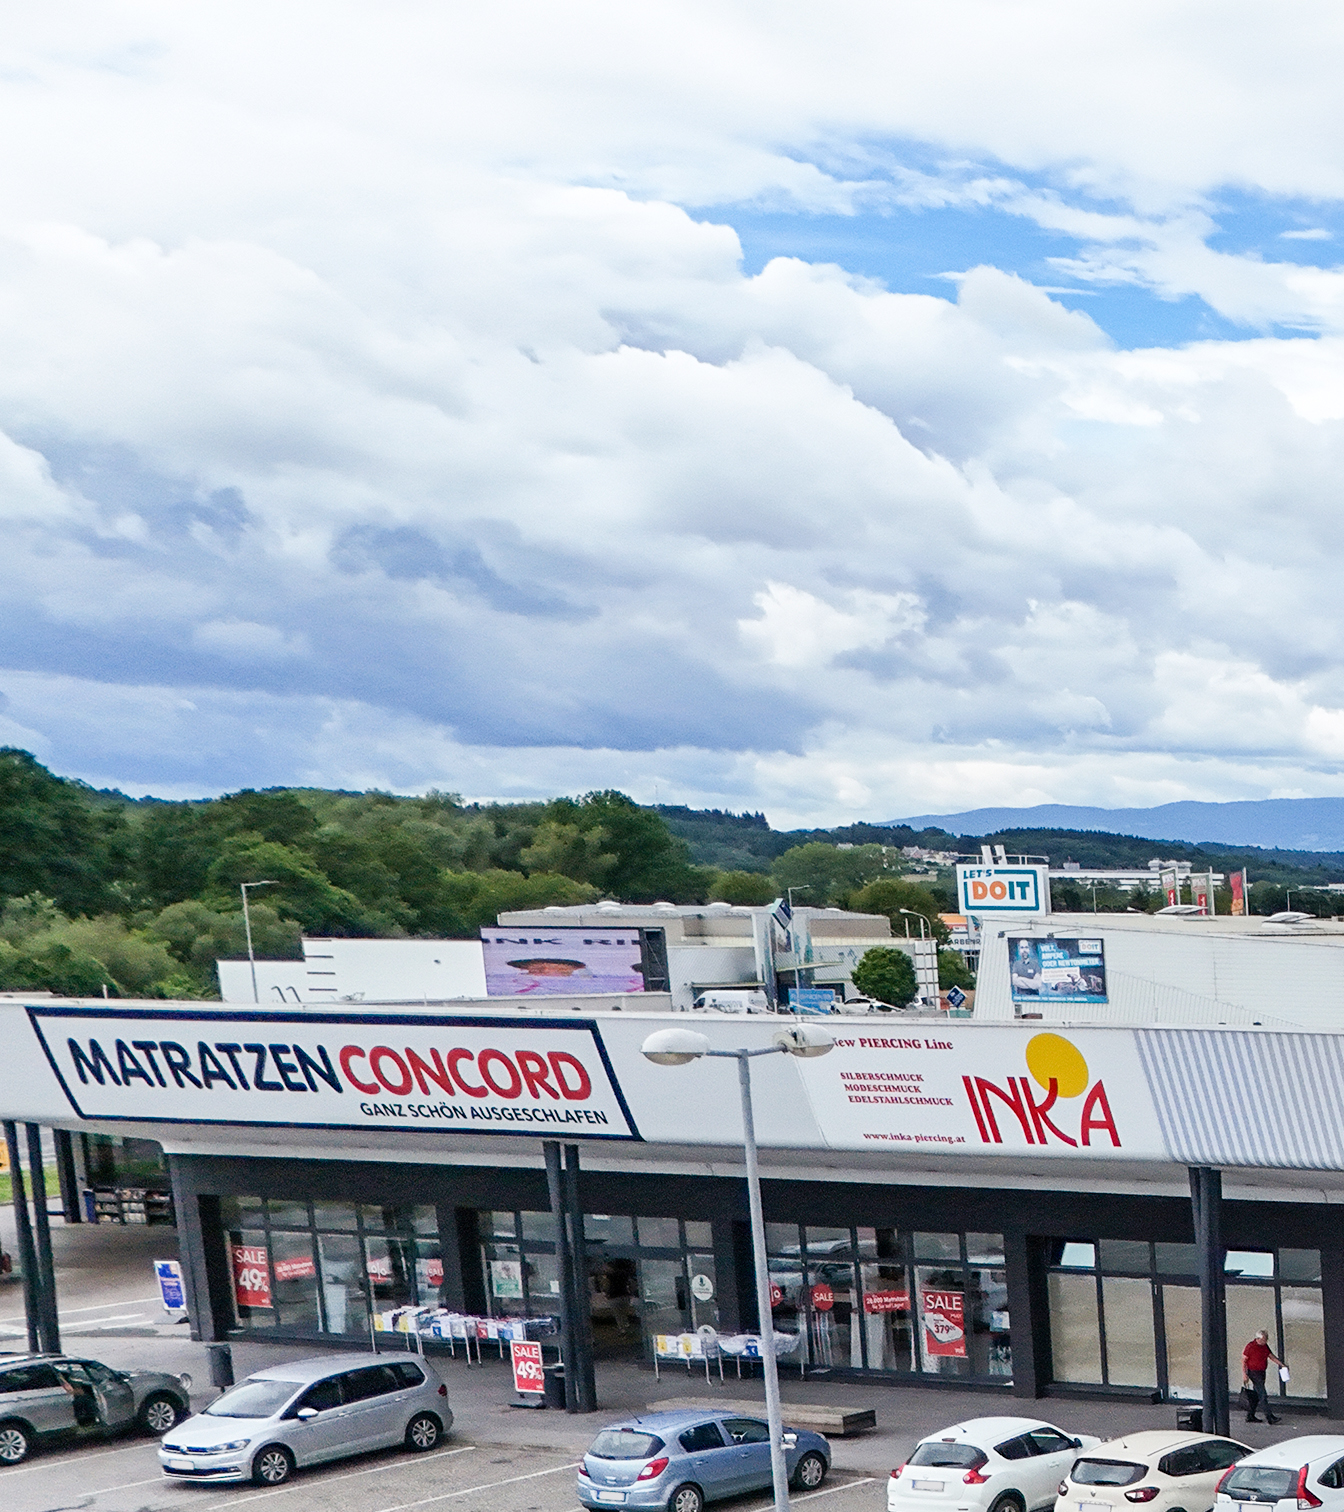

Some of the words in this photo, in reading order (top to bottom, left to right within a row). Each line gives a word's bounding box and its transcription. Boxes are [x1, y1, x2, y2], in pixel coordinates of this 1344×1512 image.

[963, 869, 992, 880] LET'S
[859, 1037, 922, 1049] PIERCING
[924, 1038, 954, 1050] Line
[67, 1037, 343, 1094] MATRATZEN
[340, 1044, 592, 1101] CONCORD
[840, 1071, 924, 1082] SILBERSCHMUCK
[844, 1083, 922, 1094] MODESCHMUCK
[848, 1094, 954, 1106] EDELSTAHLSCHMUCK
[359, 1101, 405, 1119] GANZ
[410, 1101, 467, 1121] SCHÖN
[470, 1105, 608, 1125] AUSGESCHLAFEN
[961, 1075, 1122, 1148] INKA
[863, 1131, 966, 1145] www.inka-piercing.at
[236, 1249, 266, 1265] SALE
[813, 1292, 834, 1303] SALE
[926, 1294, 962, 1310] SALE
[513, 1346, 539, 1358] SALE
